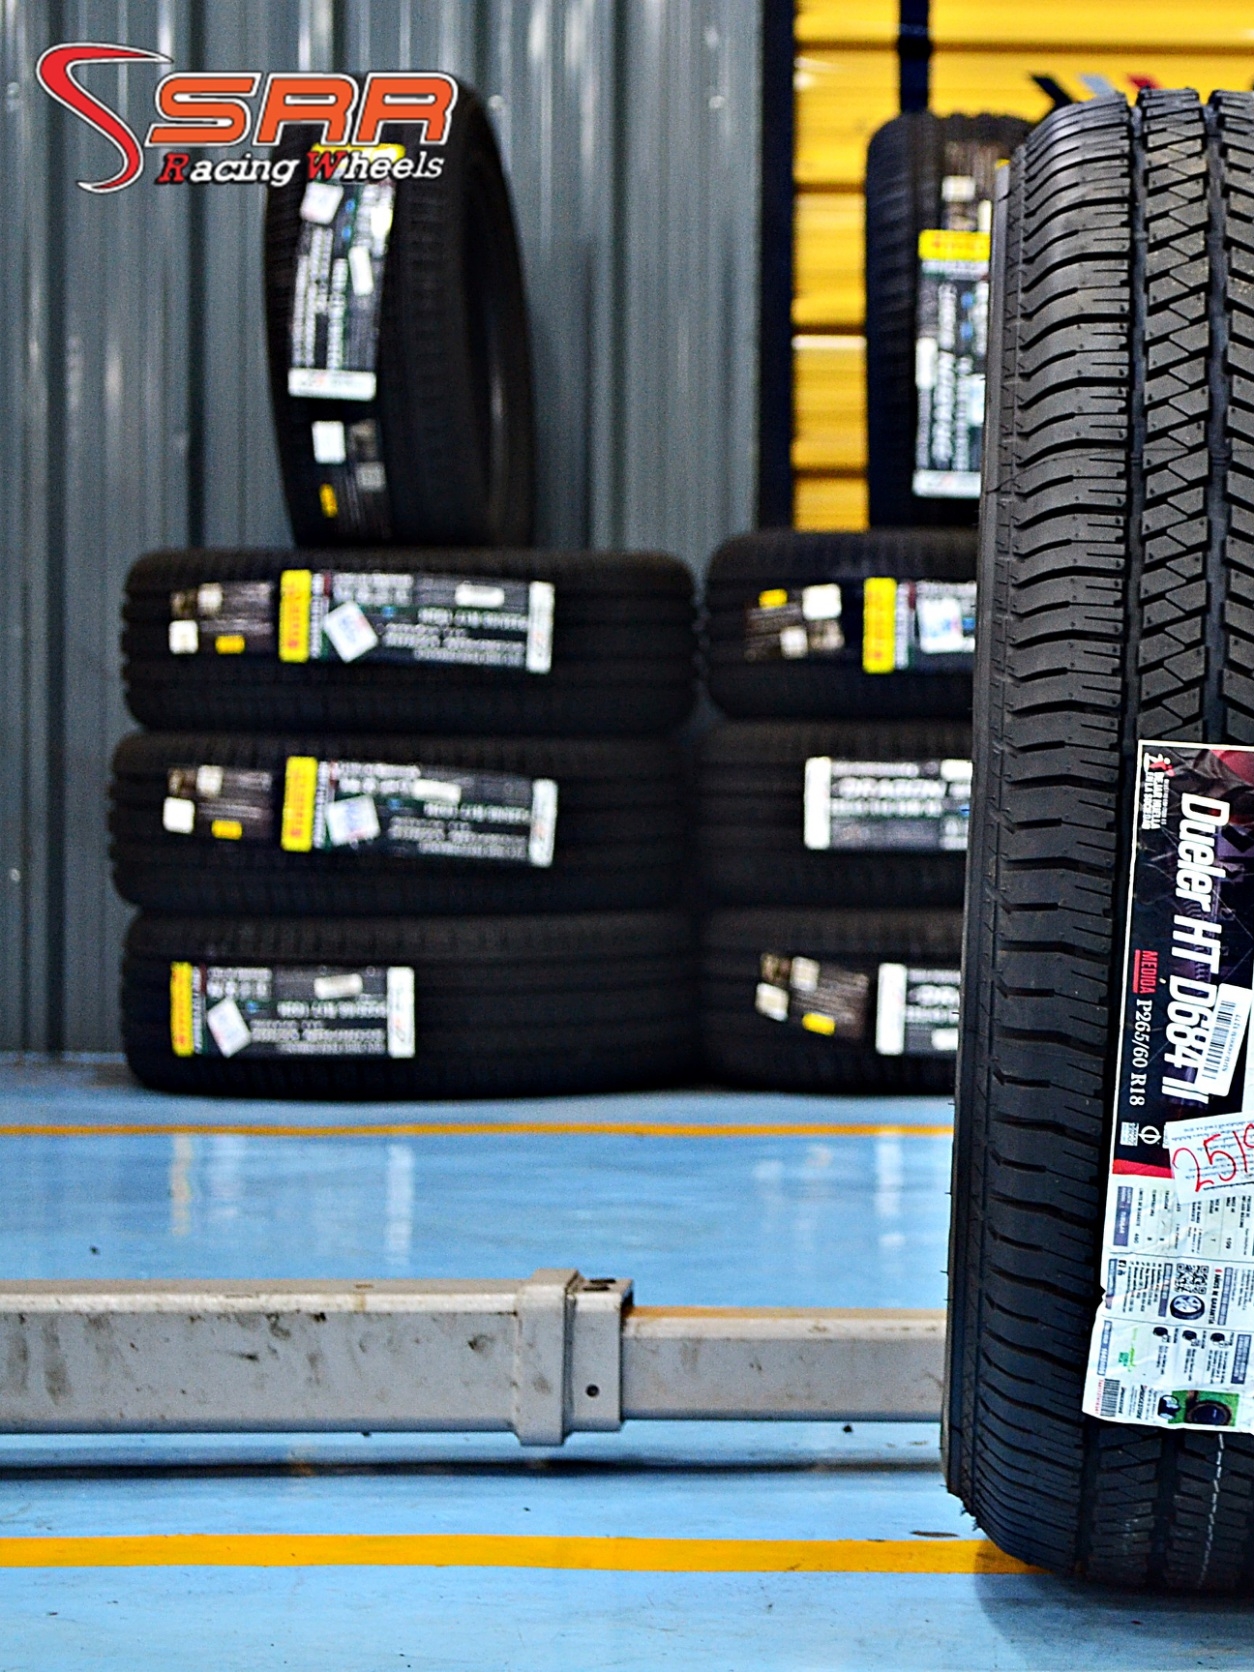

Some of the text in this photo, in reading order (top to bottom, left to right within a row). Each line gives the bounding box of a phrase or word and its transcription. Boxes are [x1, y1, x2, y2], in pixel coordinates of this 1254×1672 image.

[1175, 792, 1230, 913] Dueler
[1140, 949, 1158, 994] MEDIDA
[1171, 914, 1222, 975] HT
[1132, 999, 1153, 1069] P265/60
[1163, 974, 1218, 1069] D684
[1129, 1072, 1147, 1106] R18
